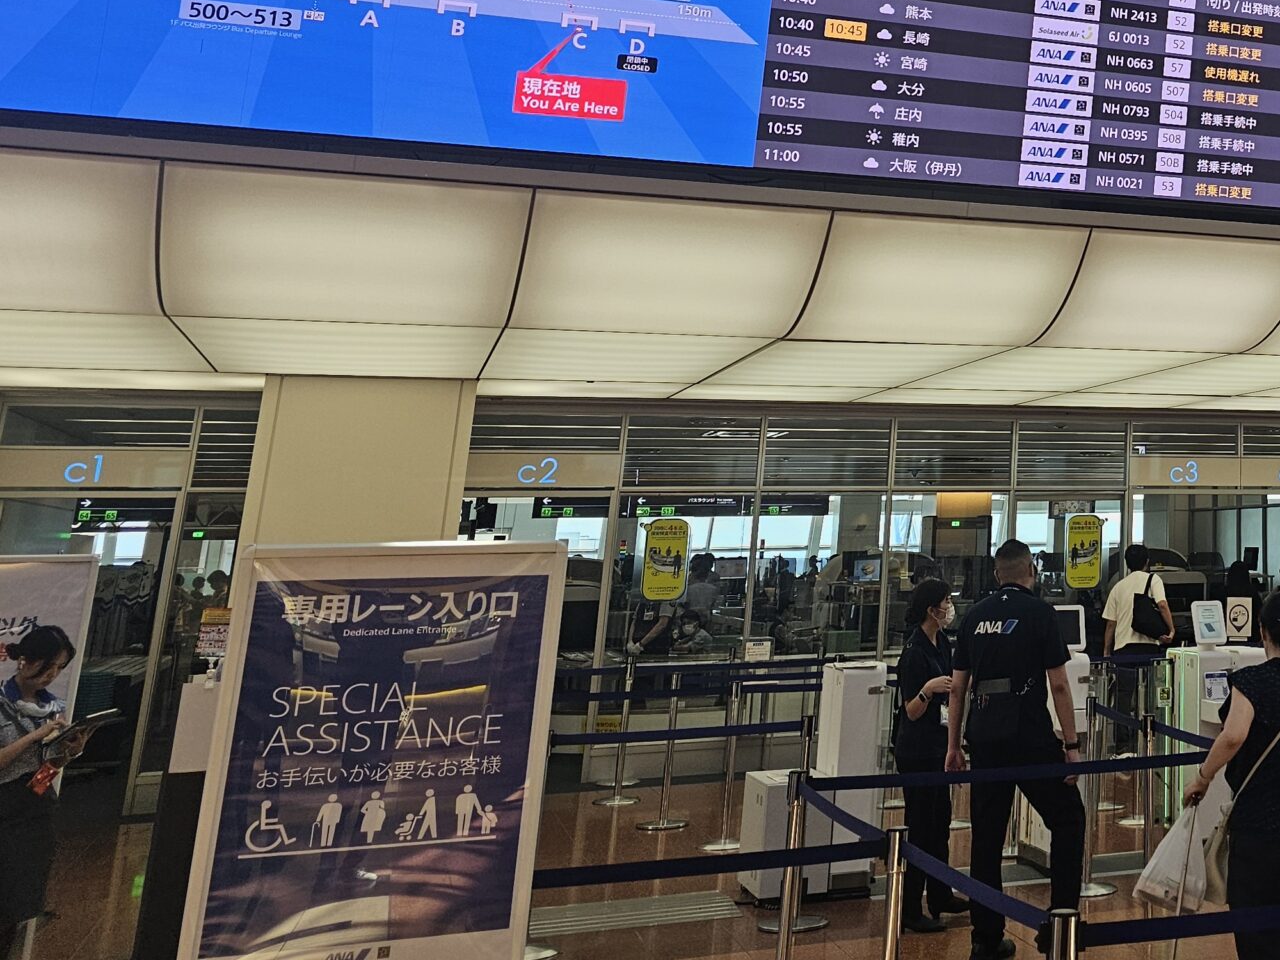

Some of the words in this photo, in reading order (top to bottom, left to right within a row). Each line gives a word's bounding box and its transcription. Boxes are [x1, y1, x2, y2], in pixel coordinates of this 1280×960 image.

[360, 10, 379, 28] A
[678, 4, 712, 19] 150m
[451, 20, 465, 36] B
[573, 33, 587, 49] C
[629, 39, 645, 54] D
[778, 16, 814, 32] 10:40
[829, 23, 863, 36] 10:45
[902, 30, 930, 47] 長崎
[1107, 55, 1124, 67] NH
[1127, 57, 1153, 70] 0663
[1171, 62, 1183, 72] 57
[1205, 66, 1260, 84] 使用機遅れ
[623, 63, 650, 72] CLOSED
[522, 77, 580, 99] 現在地
[521, 95, 549, 111] You
[553, 97, 579, 112] Are
[584, 100, 618, 115] Here
[764, 147, 800, 163] 11:00
[1096, 175, 1114, 187] NH
[1116, 177, 1143, 189] 0021
[1162, 181, 1174, 192] 53
[1195, 183, 1252, 200] 搭乗口変更
[79, 512, 89, 520] 64
[106, 512, 116, 520] 65
[282, 591, 518, 625] 専用レーン入り口
[343, 627, 388, 637] Dedicated
[391, 626, 414, 635] Lane
[416, 625, 457, 635] Entrance
[974, 620, 1003, 635] ANA
[269, 681, 427, 718] SPECIAL
[262, 713, 504, 757] ASSISTANCE
[256, 754, 502, 790] お手伝いが必要なお客様
